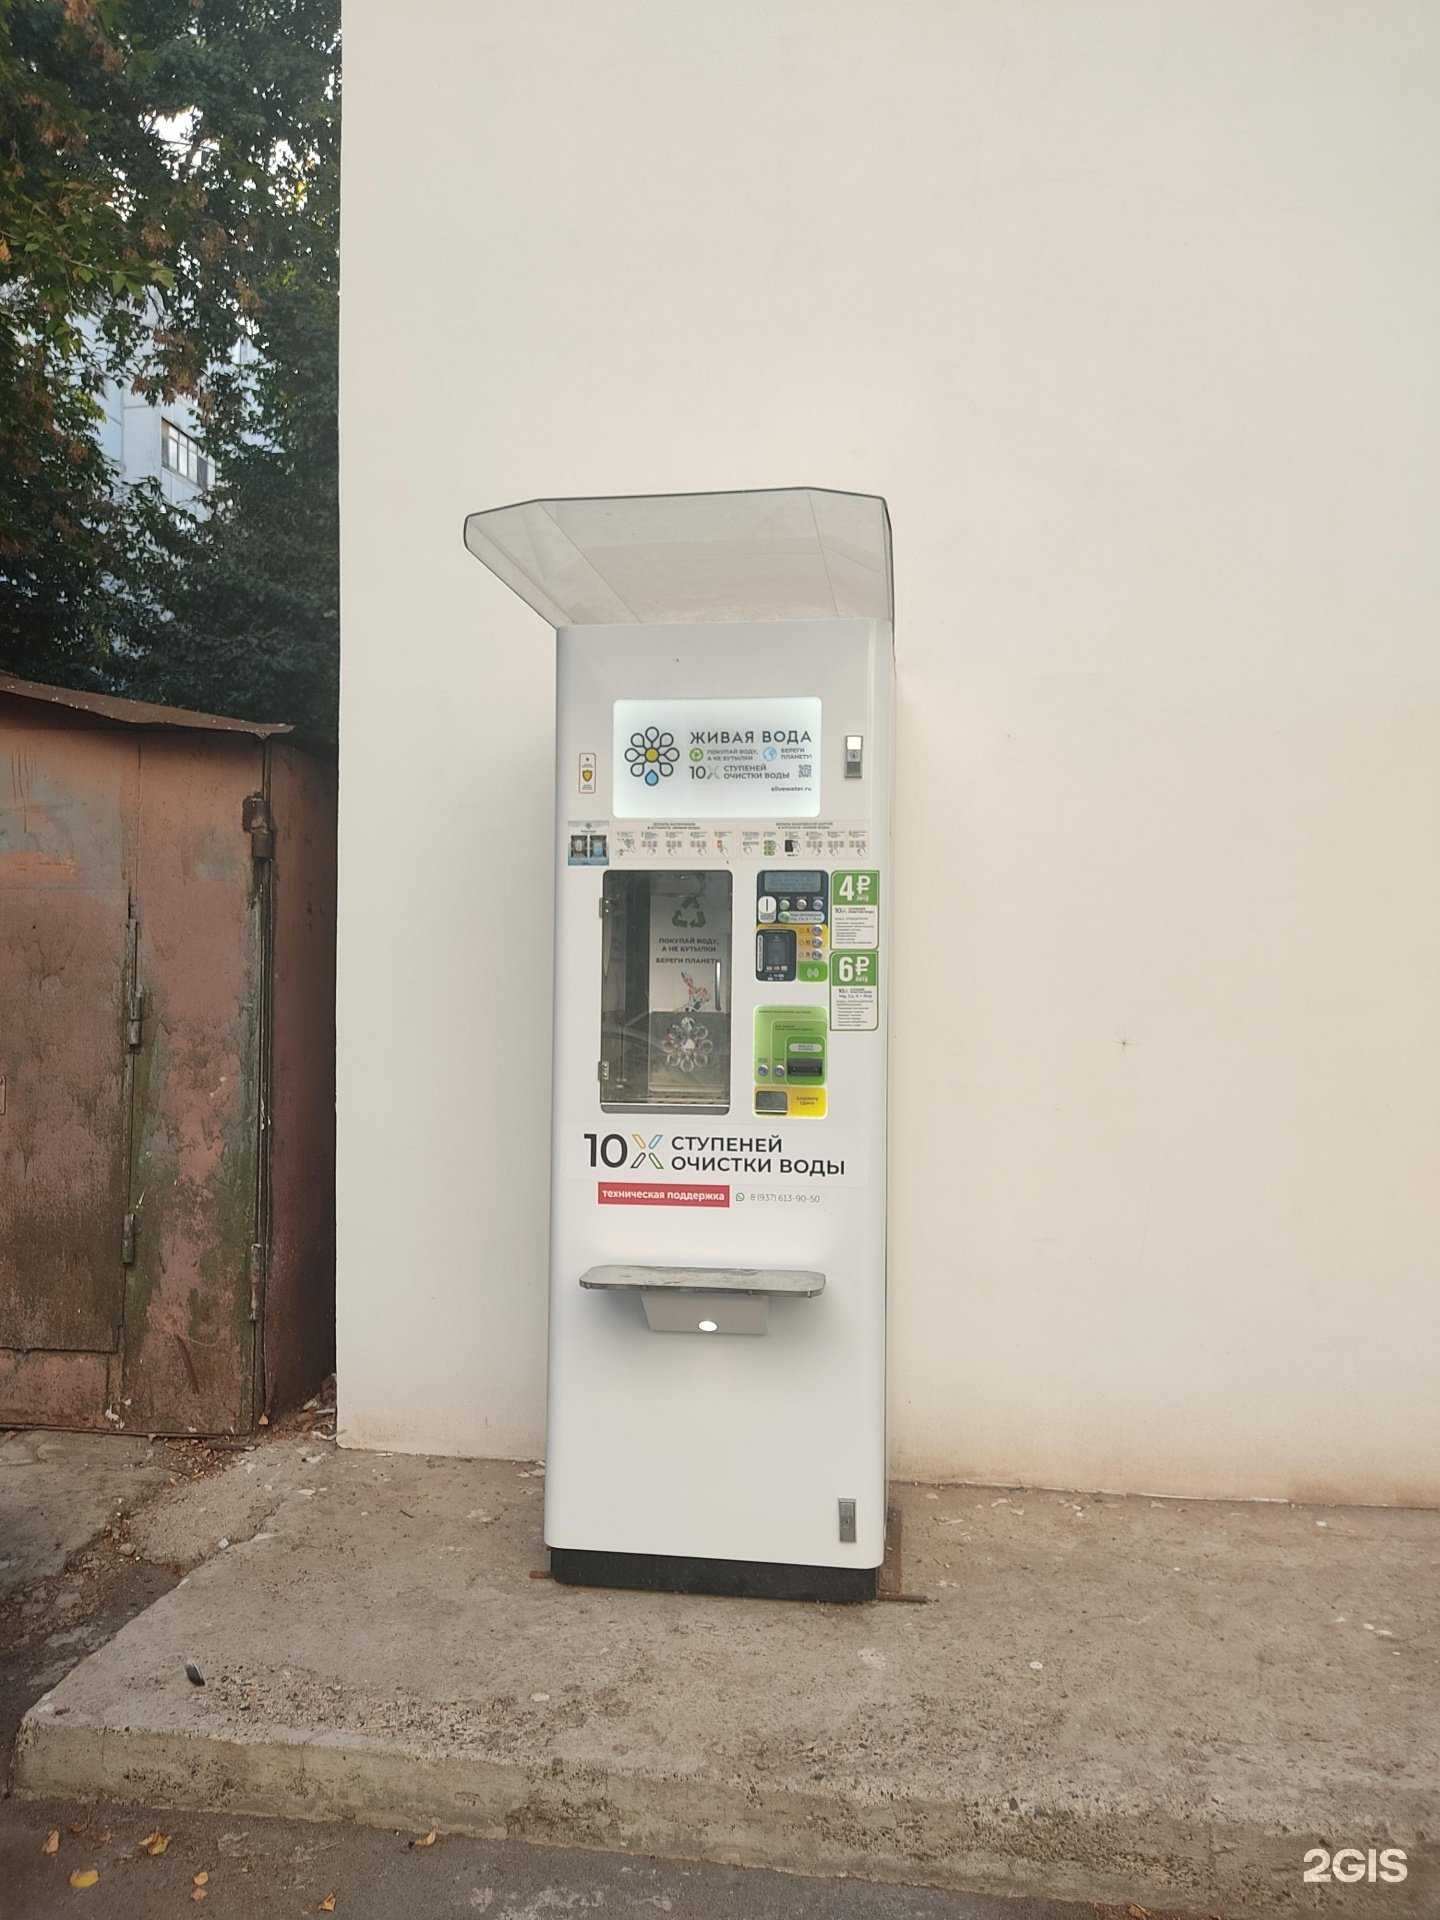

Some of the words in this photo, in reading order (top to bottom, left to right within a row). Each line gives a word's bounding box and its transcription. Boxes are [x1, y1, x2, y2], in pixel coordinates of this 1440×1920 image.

[689, 731, 754, 744] ЖИВАЯ
[762, 730, 812, 744] ВОДА
[723, 763, 767, 772] СТУПЕНЕЙ
[723, 772, 762, 780] ОЧИСТКИ
[764, 772, 790, 780] ВОДЫ
[671, 1135, 783, 1153] СТУПЕНЕЙ
[671, 1156, 772, 1173] ОЧИСТКИ
[779, 1159, 845, 1177] ВОДЫ
[602, 1189, 665, 1199] техническая
[667, 1191, 725, 1202] поддержка
